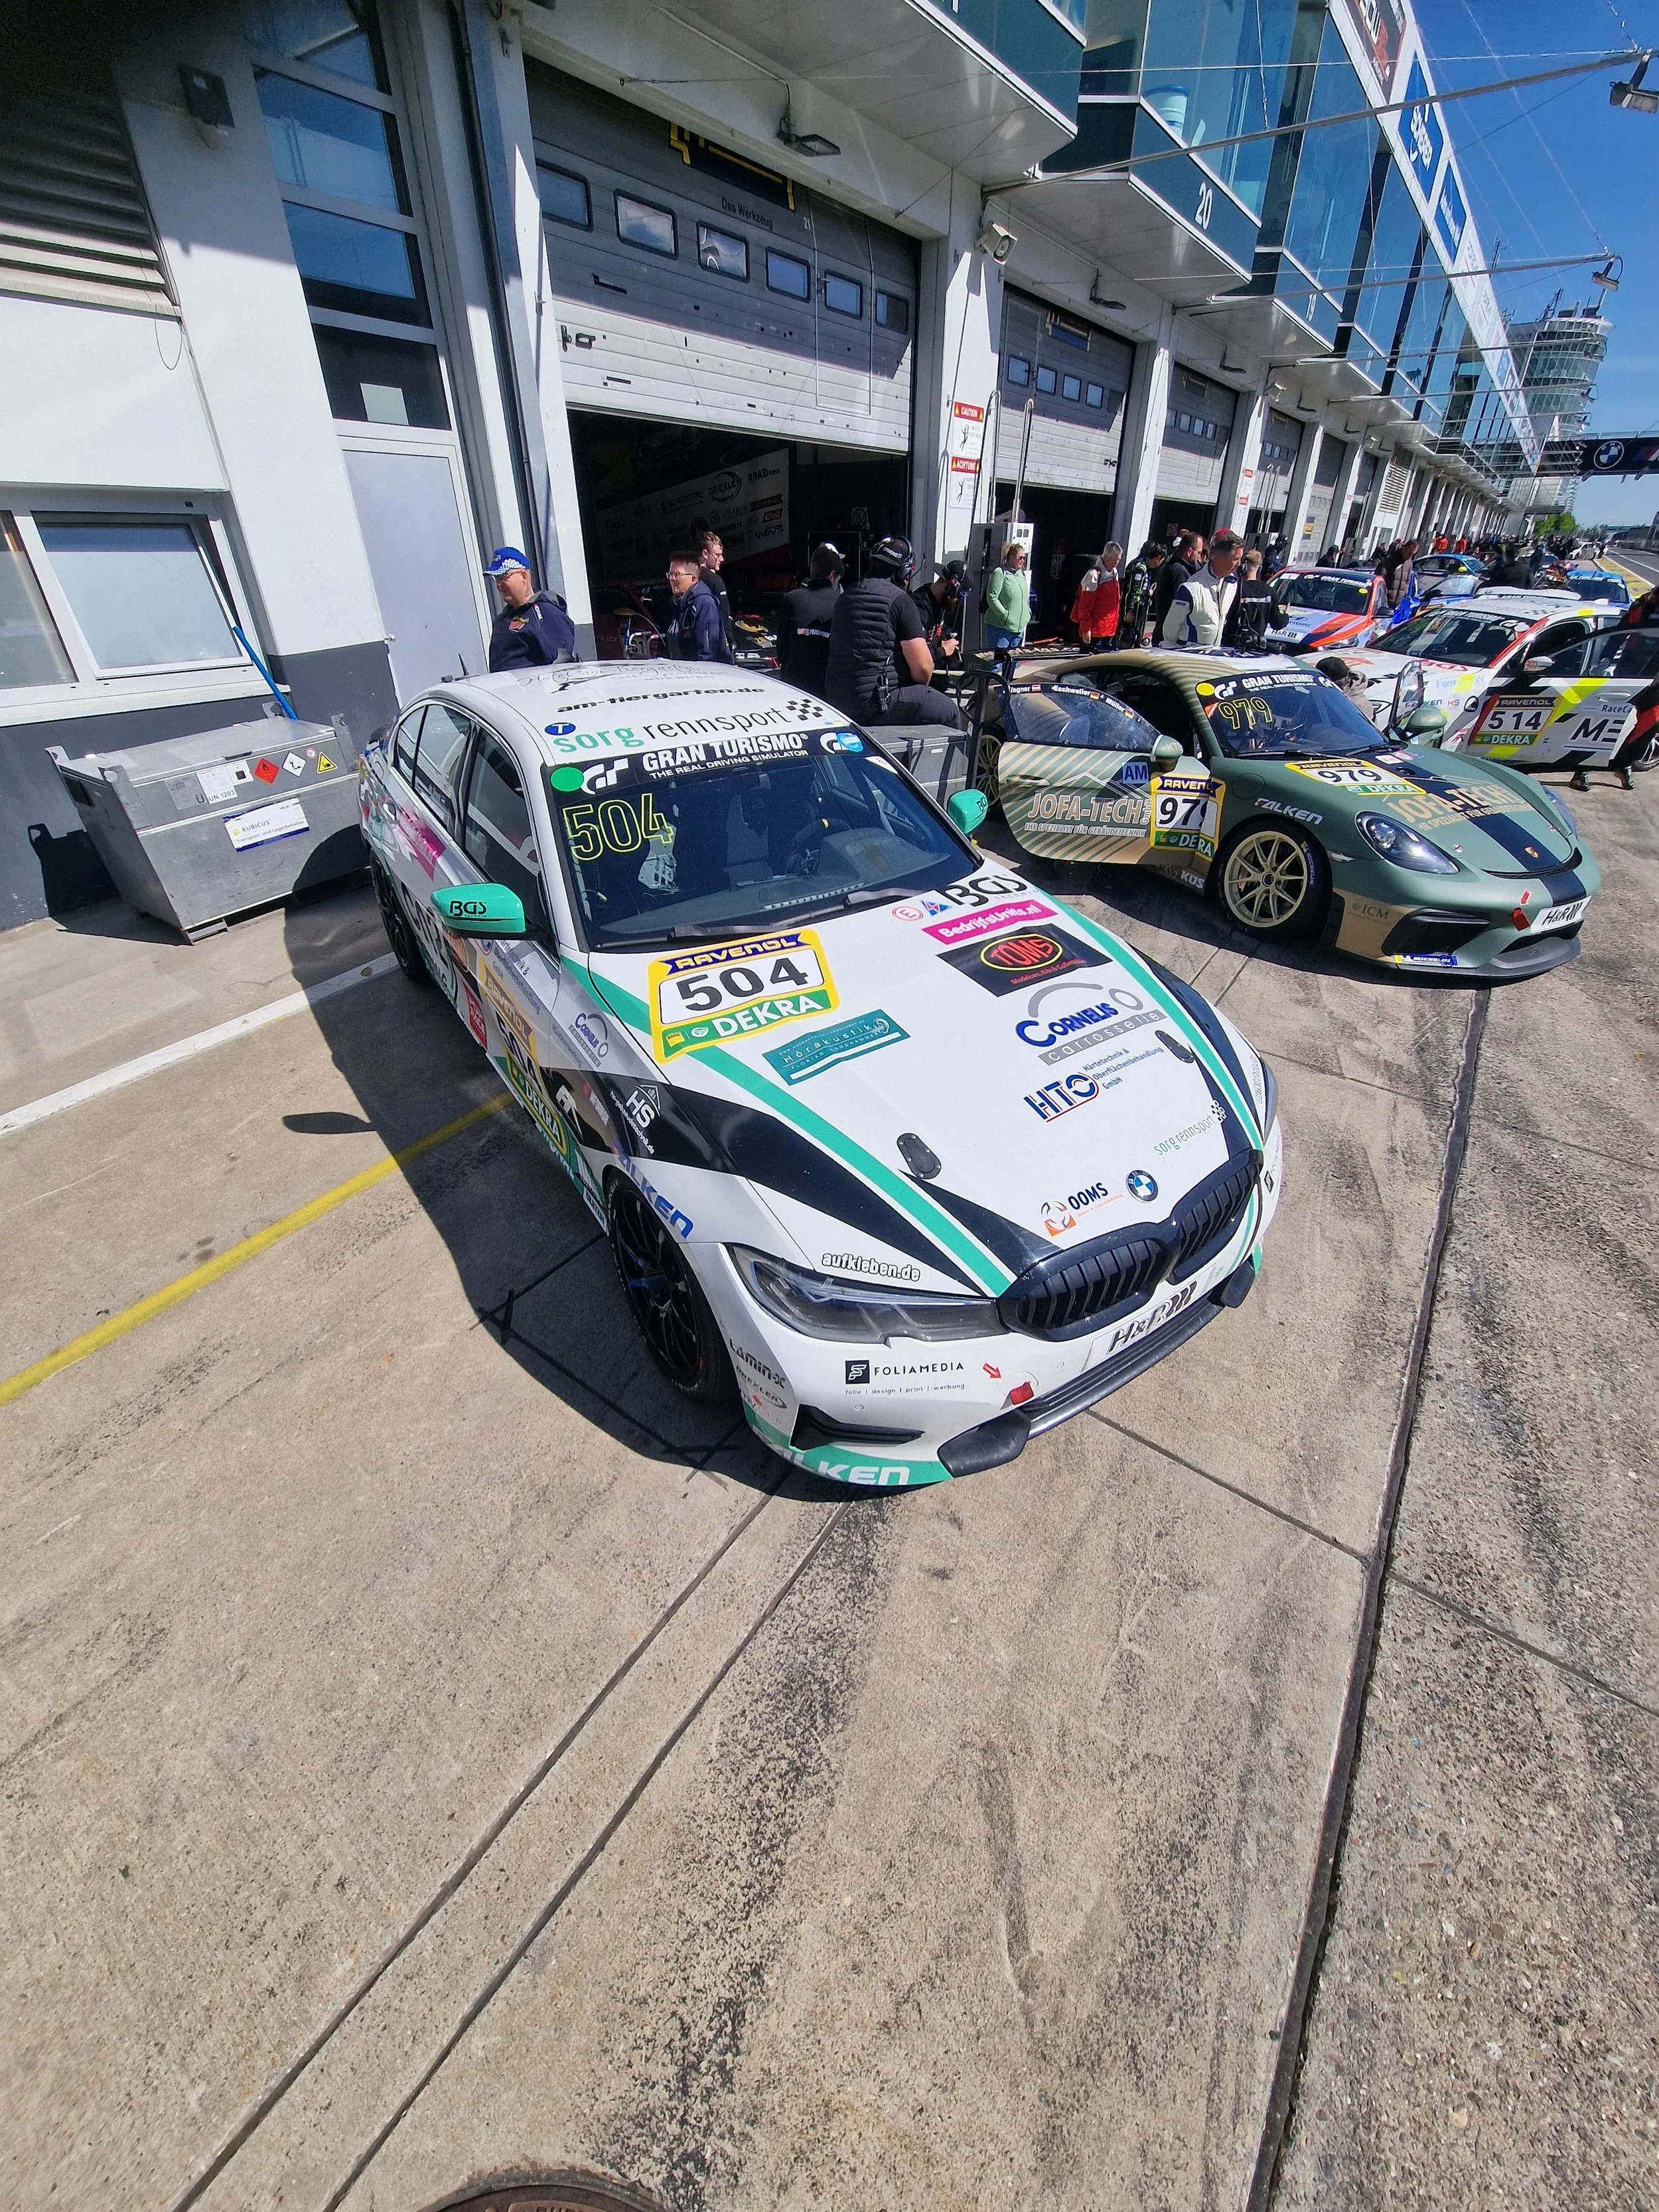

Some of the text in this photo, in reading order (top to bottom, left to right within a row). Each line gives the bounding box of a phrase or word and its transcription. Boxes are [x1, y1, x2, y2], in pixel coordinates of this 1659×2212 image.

[721, 197, 773, 231] Das Werkzeug
[1194, 181, 1213, 230] 20
[961, 406, 978, 419] CAUTION
[956, 459, 976, 471] ACHTUNG
[707, 478, 743, 496] DREXLER
[1242, 676, 1273, 689] GRAN
[556, 687, 765, 713] am-tiergarten.de
[1218, 697, 1273, 729] 979
[553, 705, 792, 753] sorg rennsport
[1491, 734, 1530, 745] DEKRA
[641, 744, 706, 772] GRAN
[649, 749, 808, 779] THE REAL DRIVING SIMULATOR
[1300, 761, 1362, 769] RAVENOL
[1124, 765, 1148, 782] AM
[1164, 779, 1213, 790] RAVENO
[1317, 769, 1382, 783] 979
[208, 790, 236, 802] UN 1203
[1368, 784, 1418, 793] DEKRA
[1027, 793, 1143, 824] JOFA-TECH
[1140, 798, 1152, 825] GmbH
[1254, 797, 1325, 825] FALKEN
[1387, 784, 1508, 824] JOFA-TECH
[236, 834, 261, 844] Transport-
[272, 820, 305, 834] Lagerbehälter
[242, 820, 270, 833] KUBICUS
[562, 793, 674, 861] 504
[1038, 824, 1074, 834] SPEZIALIST
[1074, 824, 1087, 834] FÜR
[1088, 825, 1147, 838] GEBÄUDETECHNIK
[1179, 834, 1212, 857] DERA
[938, 875, 1028, 907] BGS
[1180, 870, 1206, 889] KUS
[449, 900, 487, 917] BGS
[1360, 904, 1391, 920] ICM
[1542, 907, 1570, 926] H&R
[938, 905, 1043, 939] BedrijfsUnits.nl
[675, 936, 798, 969] RAVENOL
[989, 935, 1054, 967] TOMS
[524, 967, 531, 976] &
[676, 957, 810, 1012] 504
[488, 976, 528, 1039] RAVENOL
[714, 994, 824, 1037] DEKRA
[667, 1031, 682, 1040] ADAC
[1015, 1003, 1119, 1048] CORNELIS
[1048, 1011, 1161, 1062] carrosserie
[790, 1051, 824, 1070] FLORIAN
[1082, 1051, 1123, 1072] Härtetechnik
[1092, 1046, 1165, 1081] Oberflächenbehandlung
[1102, 1076, 1123, 1090] GmbH
[525, 1079, 561, 1143] DEKRA
[626, 1090, 655, 1128] HS
[1154, 1115, 1216, 1156] sorg rennsport
[1068, 1182, 1108, 1210] OOMS
[822, 1252, 921, 1282] aufkleben.de
[1106, 1299, 1168, 1355] H&R
[874, 1361, 964, 1377] FOLIAMEDIA
[906, 1385, 924, 1394] print
[934, 1382, 965, 1392] werbung
